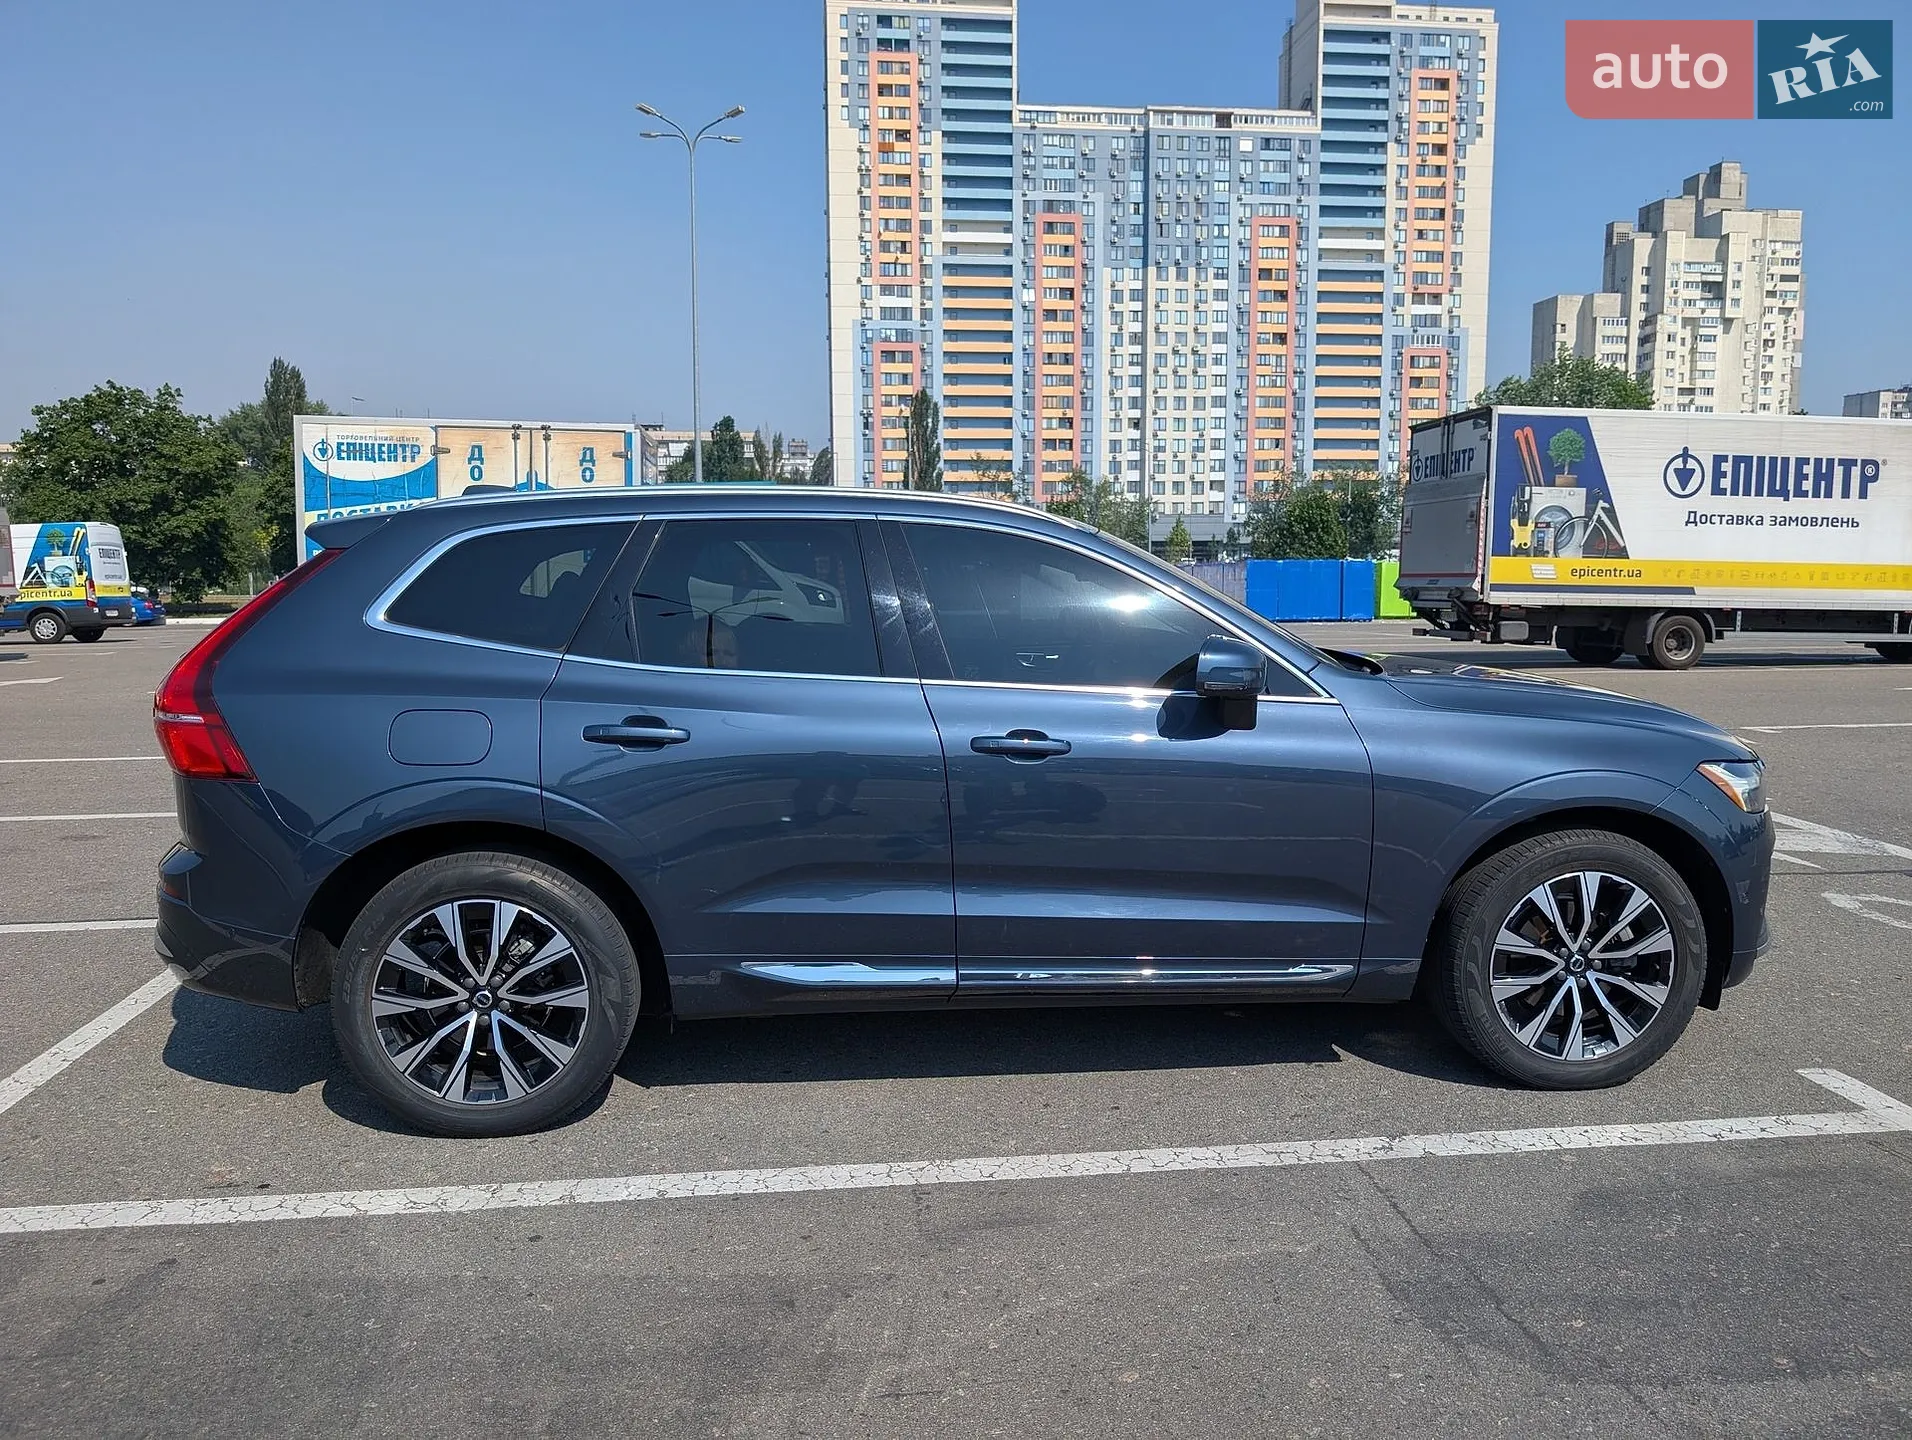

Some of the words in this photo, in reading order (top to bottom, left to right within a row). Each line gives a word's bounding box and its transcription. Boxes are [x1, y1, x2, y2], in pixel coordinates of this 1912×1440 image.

[336, 441, 421, 463] ЕПІЦЕНТР
[1710, 454, 1880, 502] ЕПІЦЕНТР
[1684, 510, 1764, 527] Доставка
[1768, 514, 1860, 529] замовлень
[1571, 566, 1642, 579] epicentr.ua
[20, 590, 73, 600] picentr.ua
